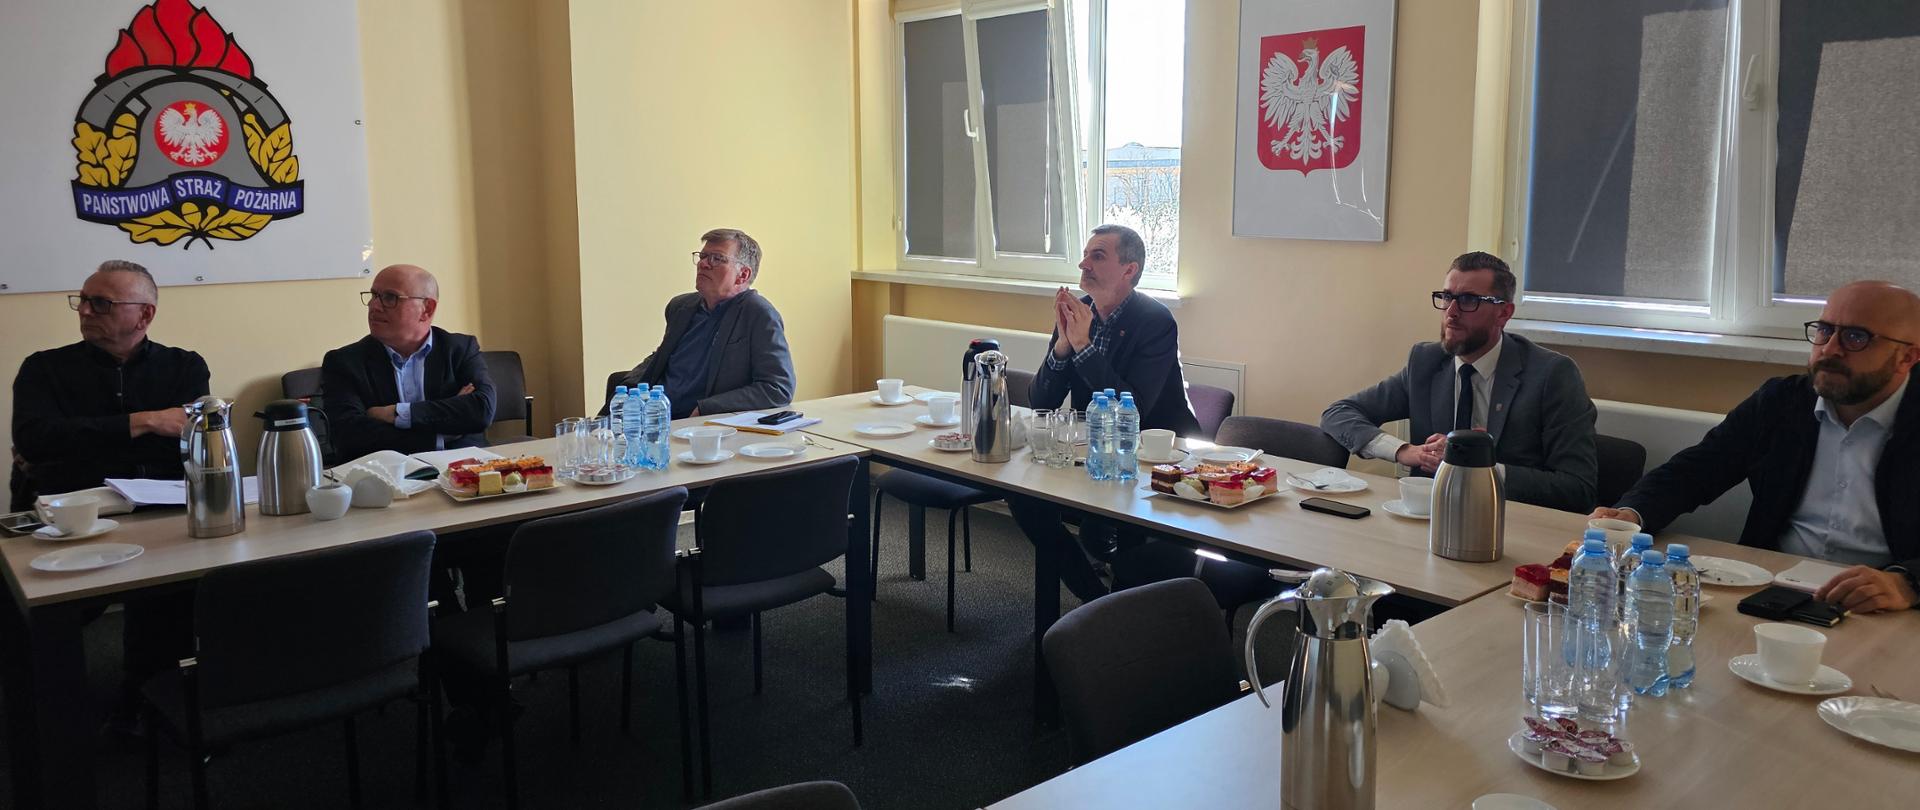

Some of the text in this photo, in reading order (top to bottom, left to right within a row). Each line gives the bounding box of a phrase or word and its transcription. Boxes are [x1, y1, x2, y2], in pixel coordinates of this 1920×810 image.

[82, 178, 297, 215] PAŃSTWOWA STRAŻ POŻARNA
